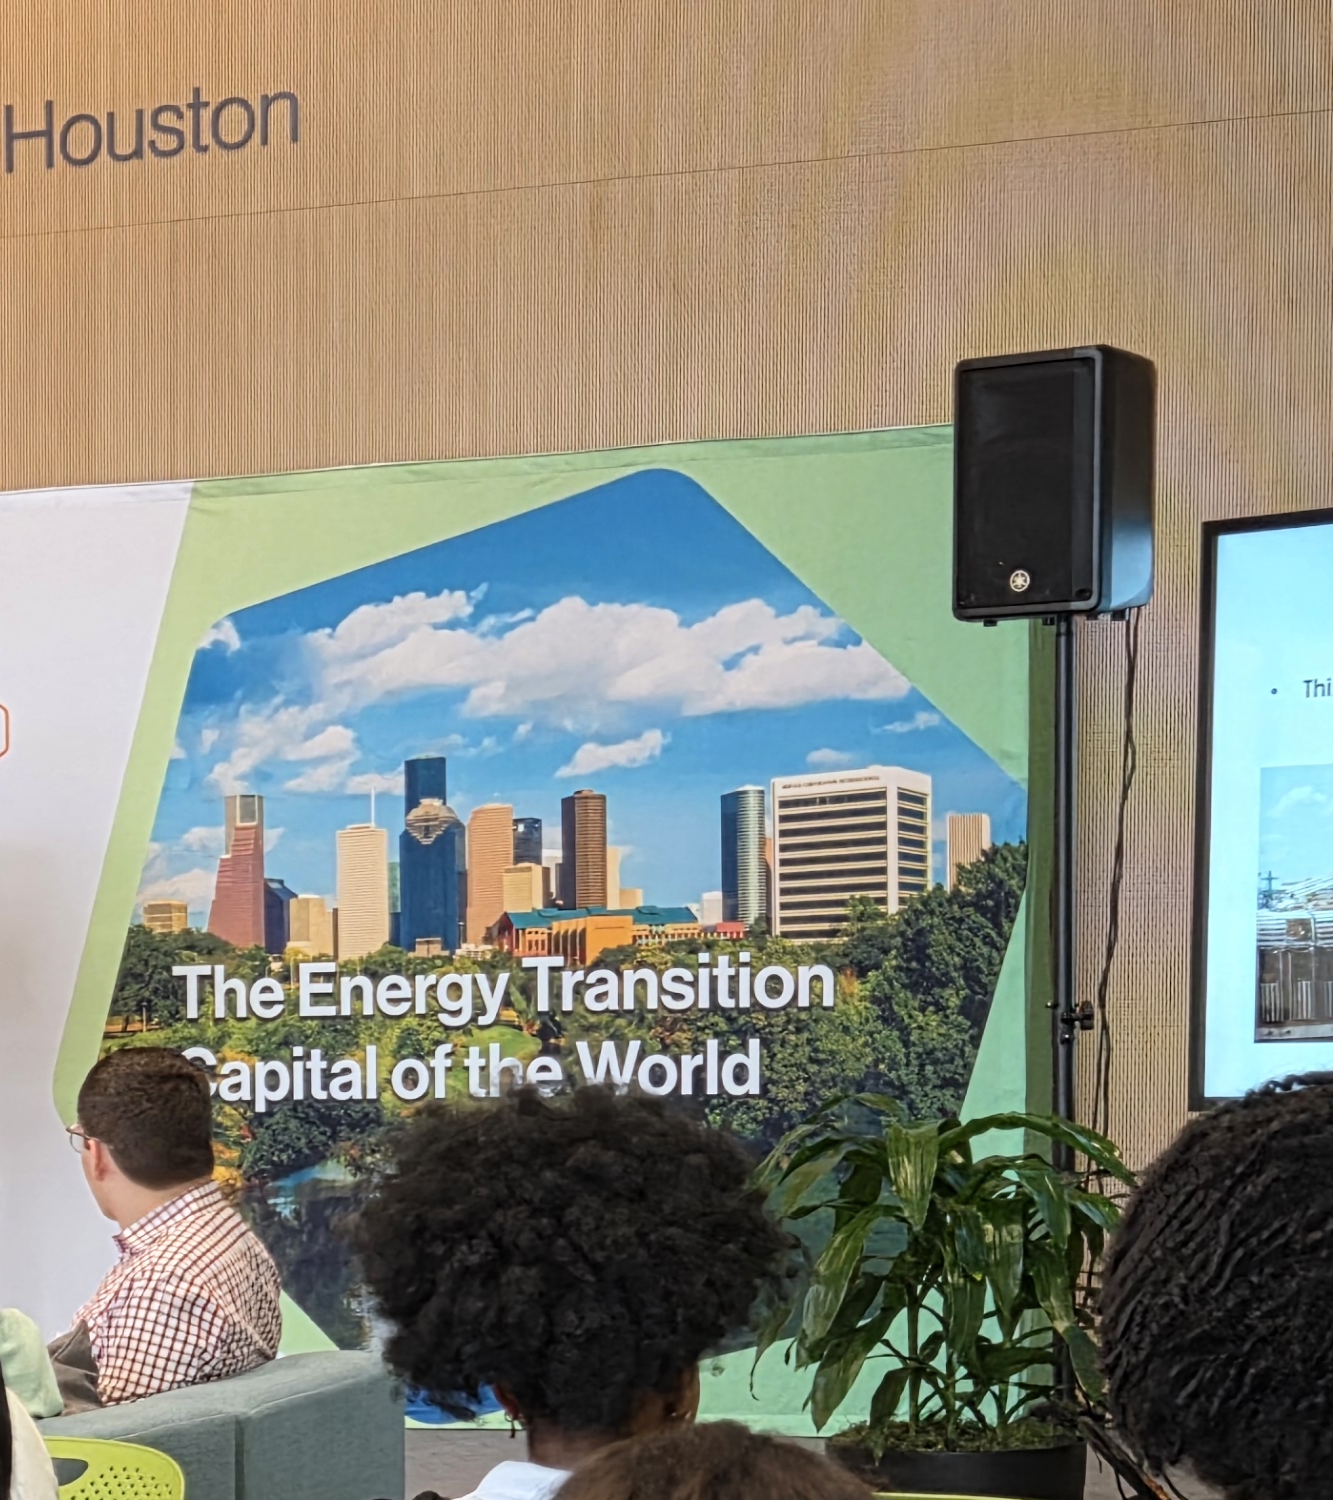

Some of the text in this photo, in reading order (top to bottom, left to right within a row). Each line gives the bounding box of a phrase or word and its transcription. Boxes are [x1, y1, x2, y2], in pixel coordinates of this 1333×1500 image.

[3, 87, 300, 174] Houston
[171, 951, 834, 1028] The Energy Transition
[390, 1042, 453, 1100] of
[463, 1042, 565, 1098] the
[576, 1038, 761, 1096] World
